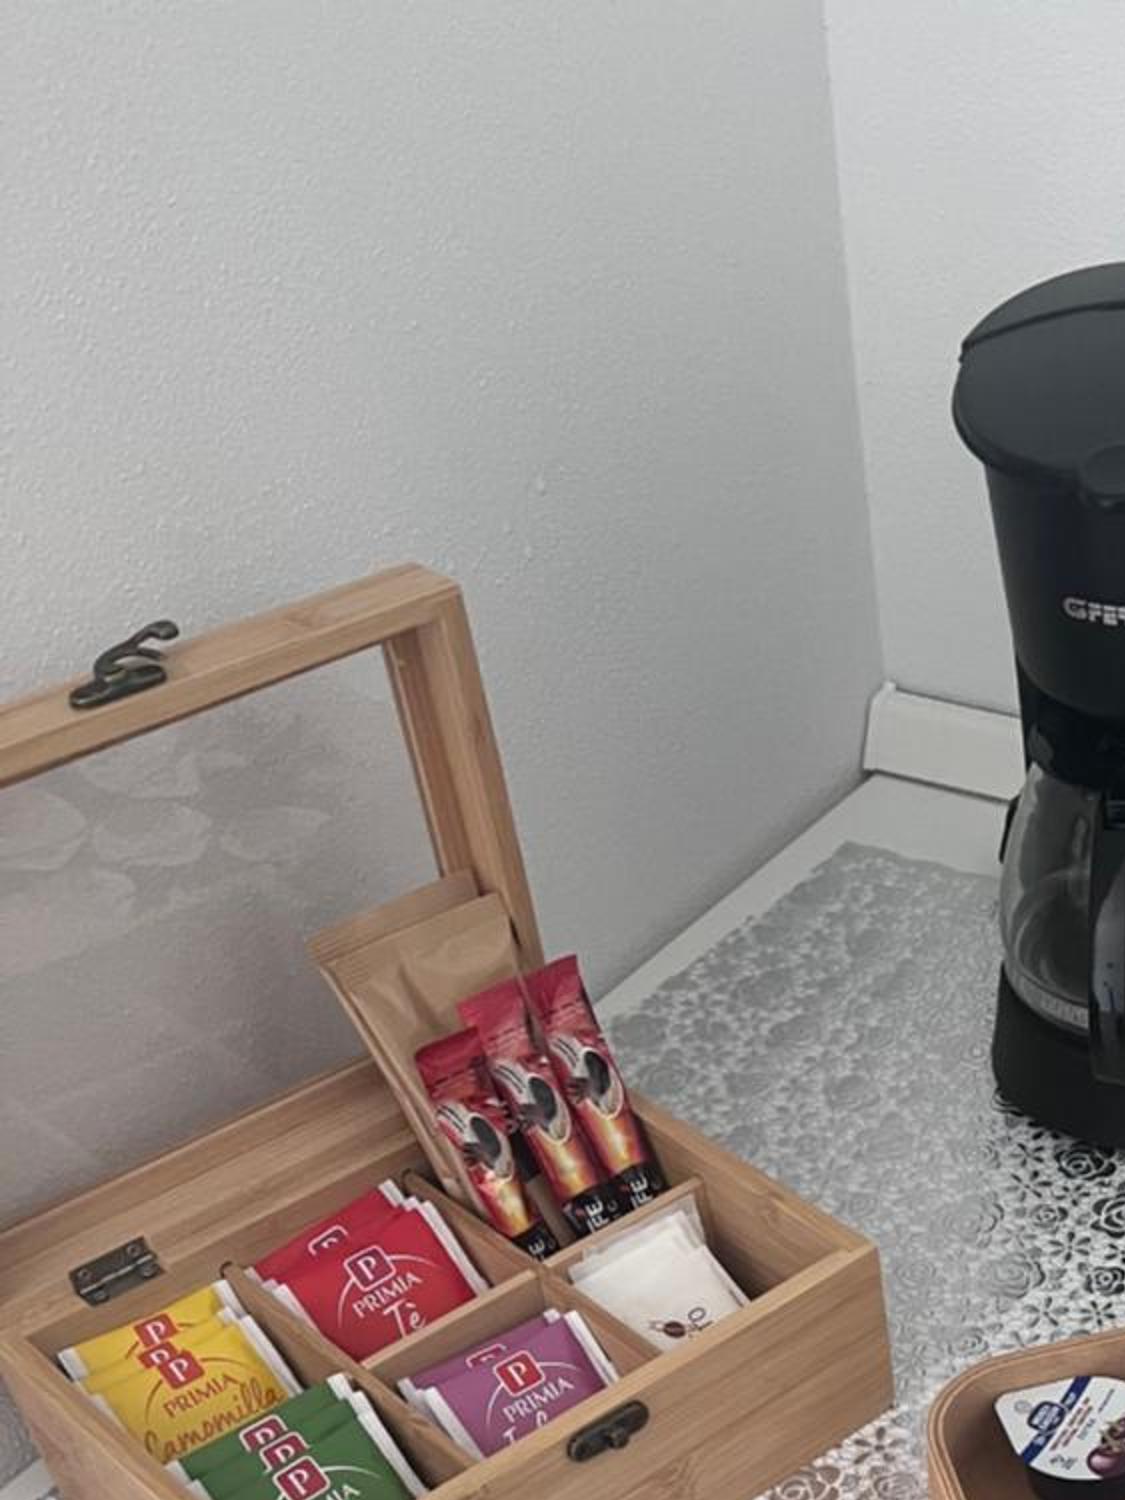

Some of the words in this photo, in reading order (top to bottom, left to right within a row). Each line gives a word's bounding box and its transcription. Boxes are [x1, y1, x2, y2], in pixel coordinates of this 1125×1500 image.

[357, 1256, 376, 1280] P
[352, 1272, 423, 1318] PRIMIA
[168, 1358, 189, 1382] P
[507, 1362, 526, 1386] P
[163, 1374, 240, 1418] PRIMIA
[502, 1377, 575, 1423] PRIMIA
[144, 1378, 277, 1464] Camomilla
[288, 1469, 309, 1495] P
